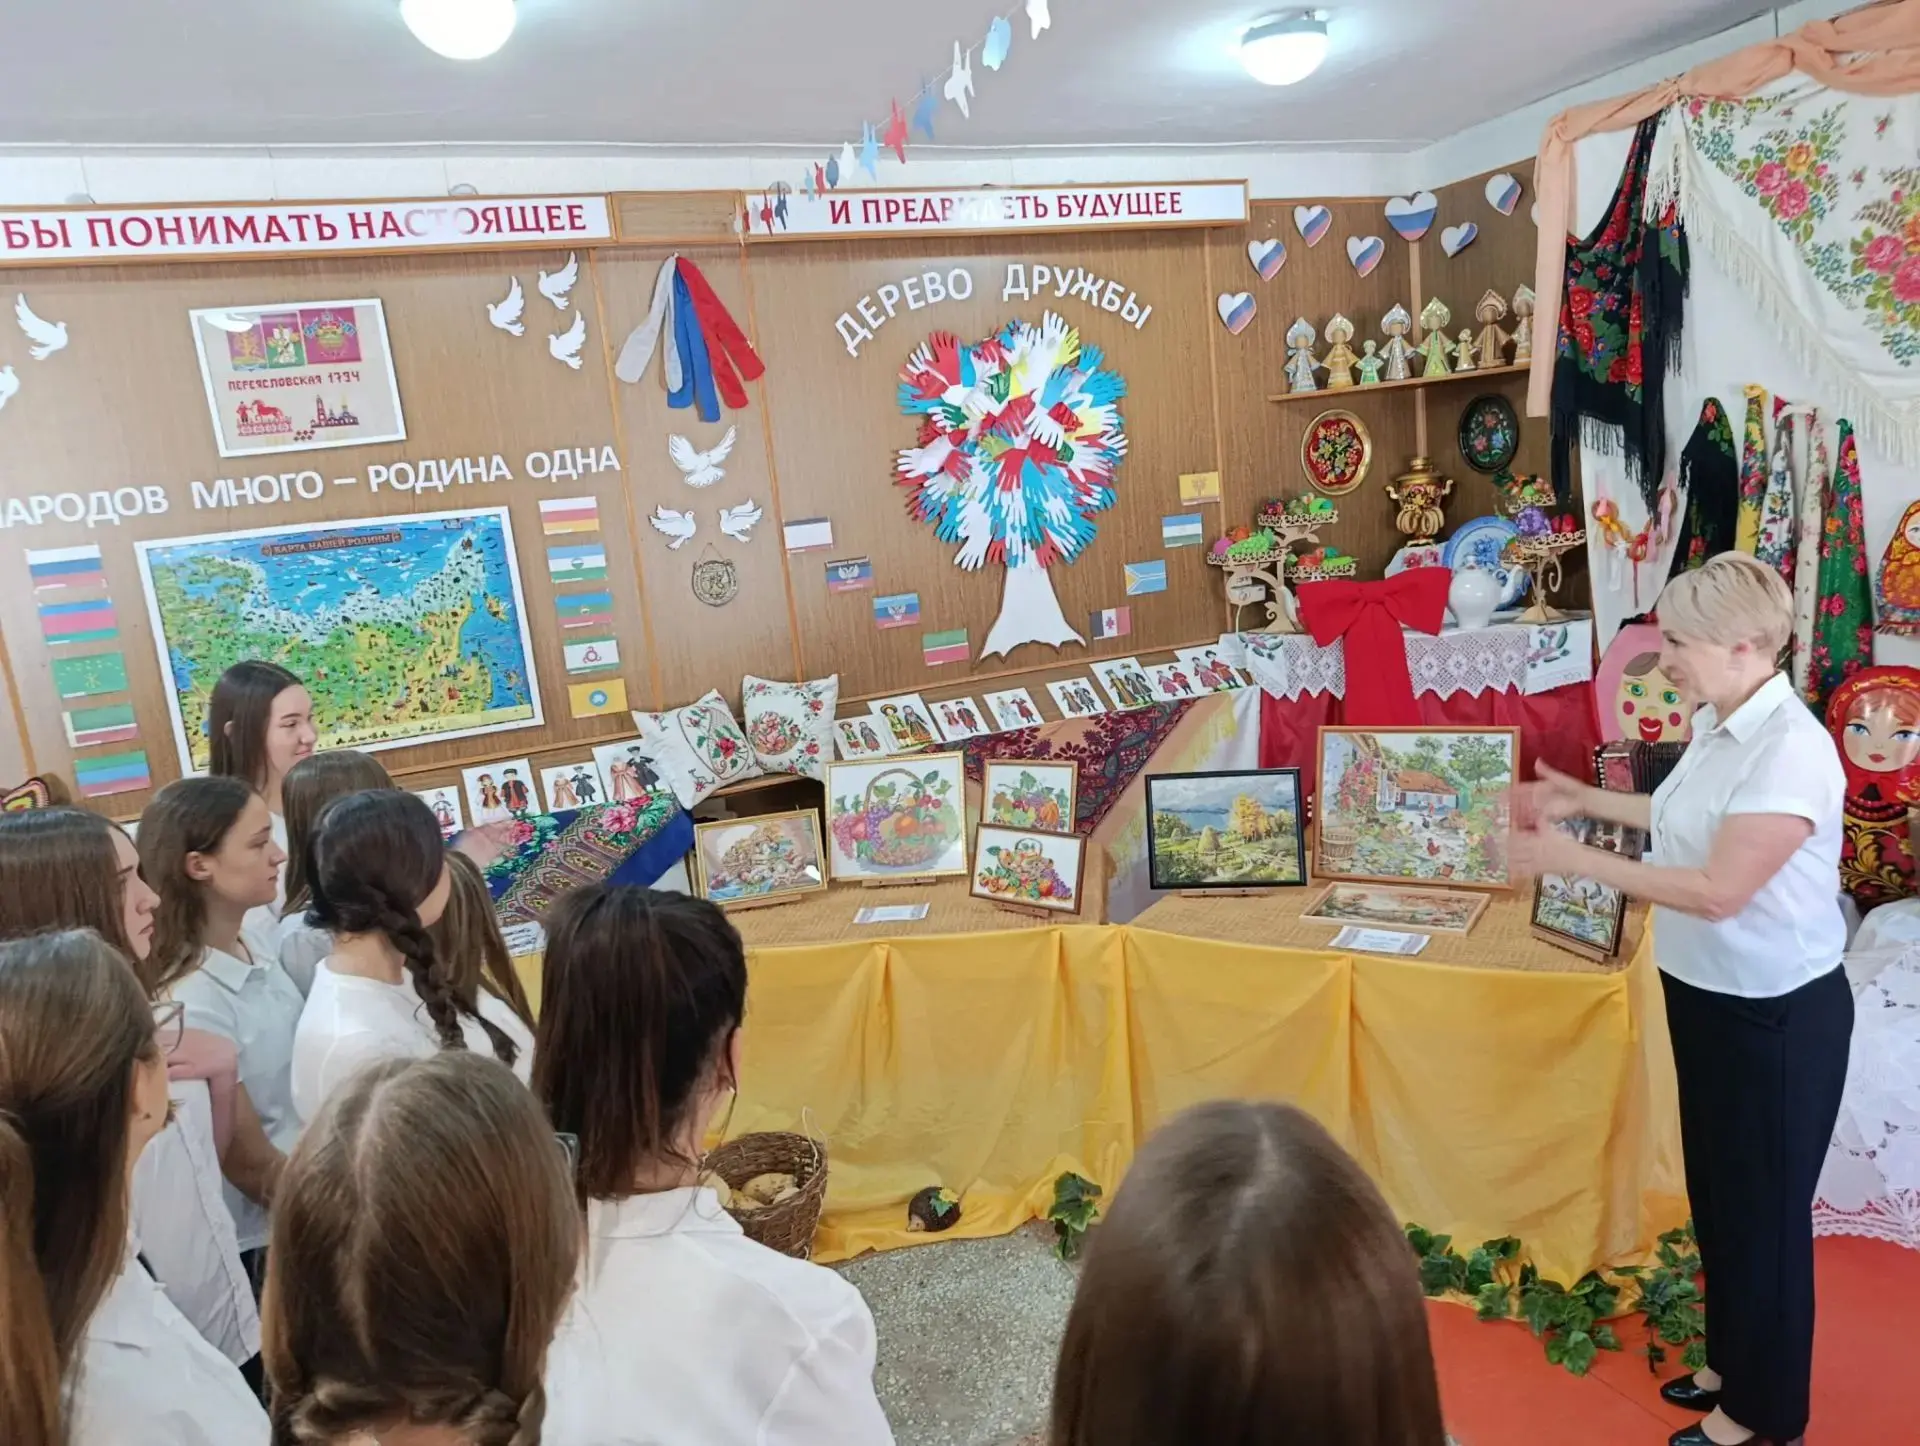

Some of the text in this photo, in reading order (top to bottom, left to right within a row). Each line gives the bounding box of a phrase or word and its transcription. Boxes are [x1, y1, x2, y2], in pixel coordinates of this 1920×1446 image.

[87, 213, 338, 247] ПОНИМАТЬ
[350, 204, 587, 240] НАСТОЯЩЕЕ
[829, 199, 852, 224] И
[1057, 191, 1182, 219] БУДУЩЕЕ
[835, 263, 1153, 358] ДЕРЕВО ДРУЖБЫ
[192, 470, 323, 510] МНОГО
[368, 454, 514, 494] РОДИНА
[525, 446, 622, 483] ОДНА
[274, 533, 391, 555] КАРТА НАШЕЙ РОДИНЫ
